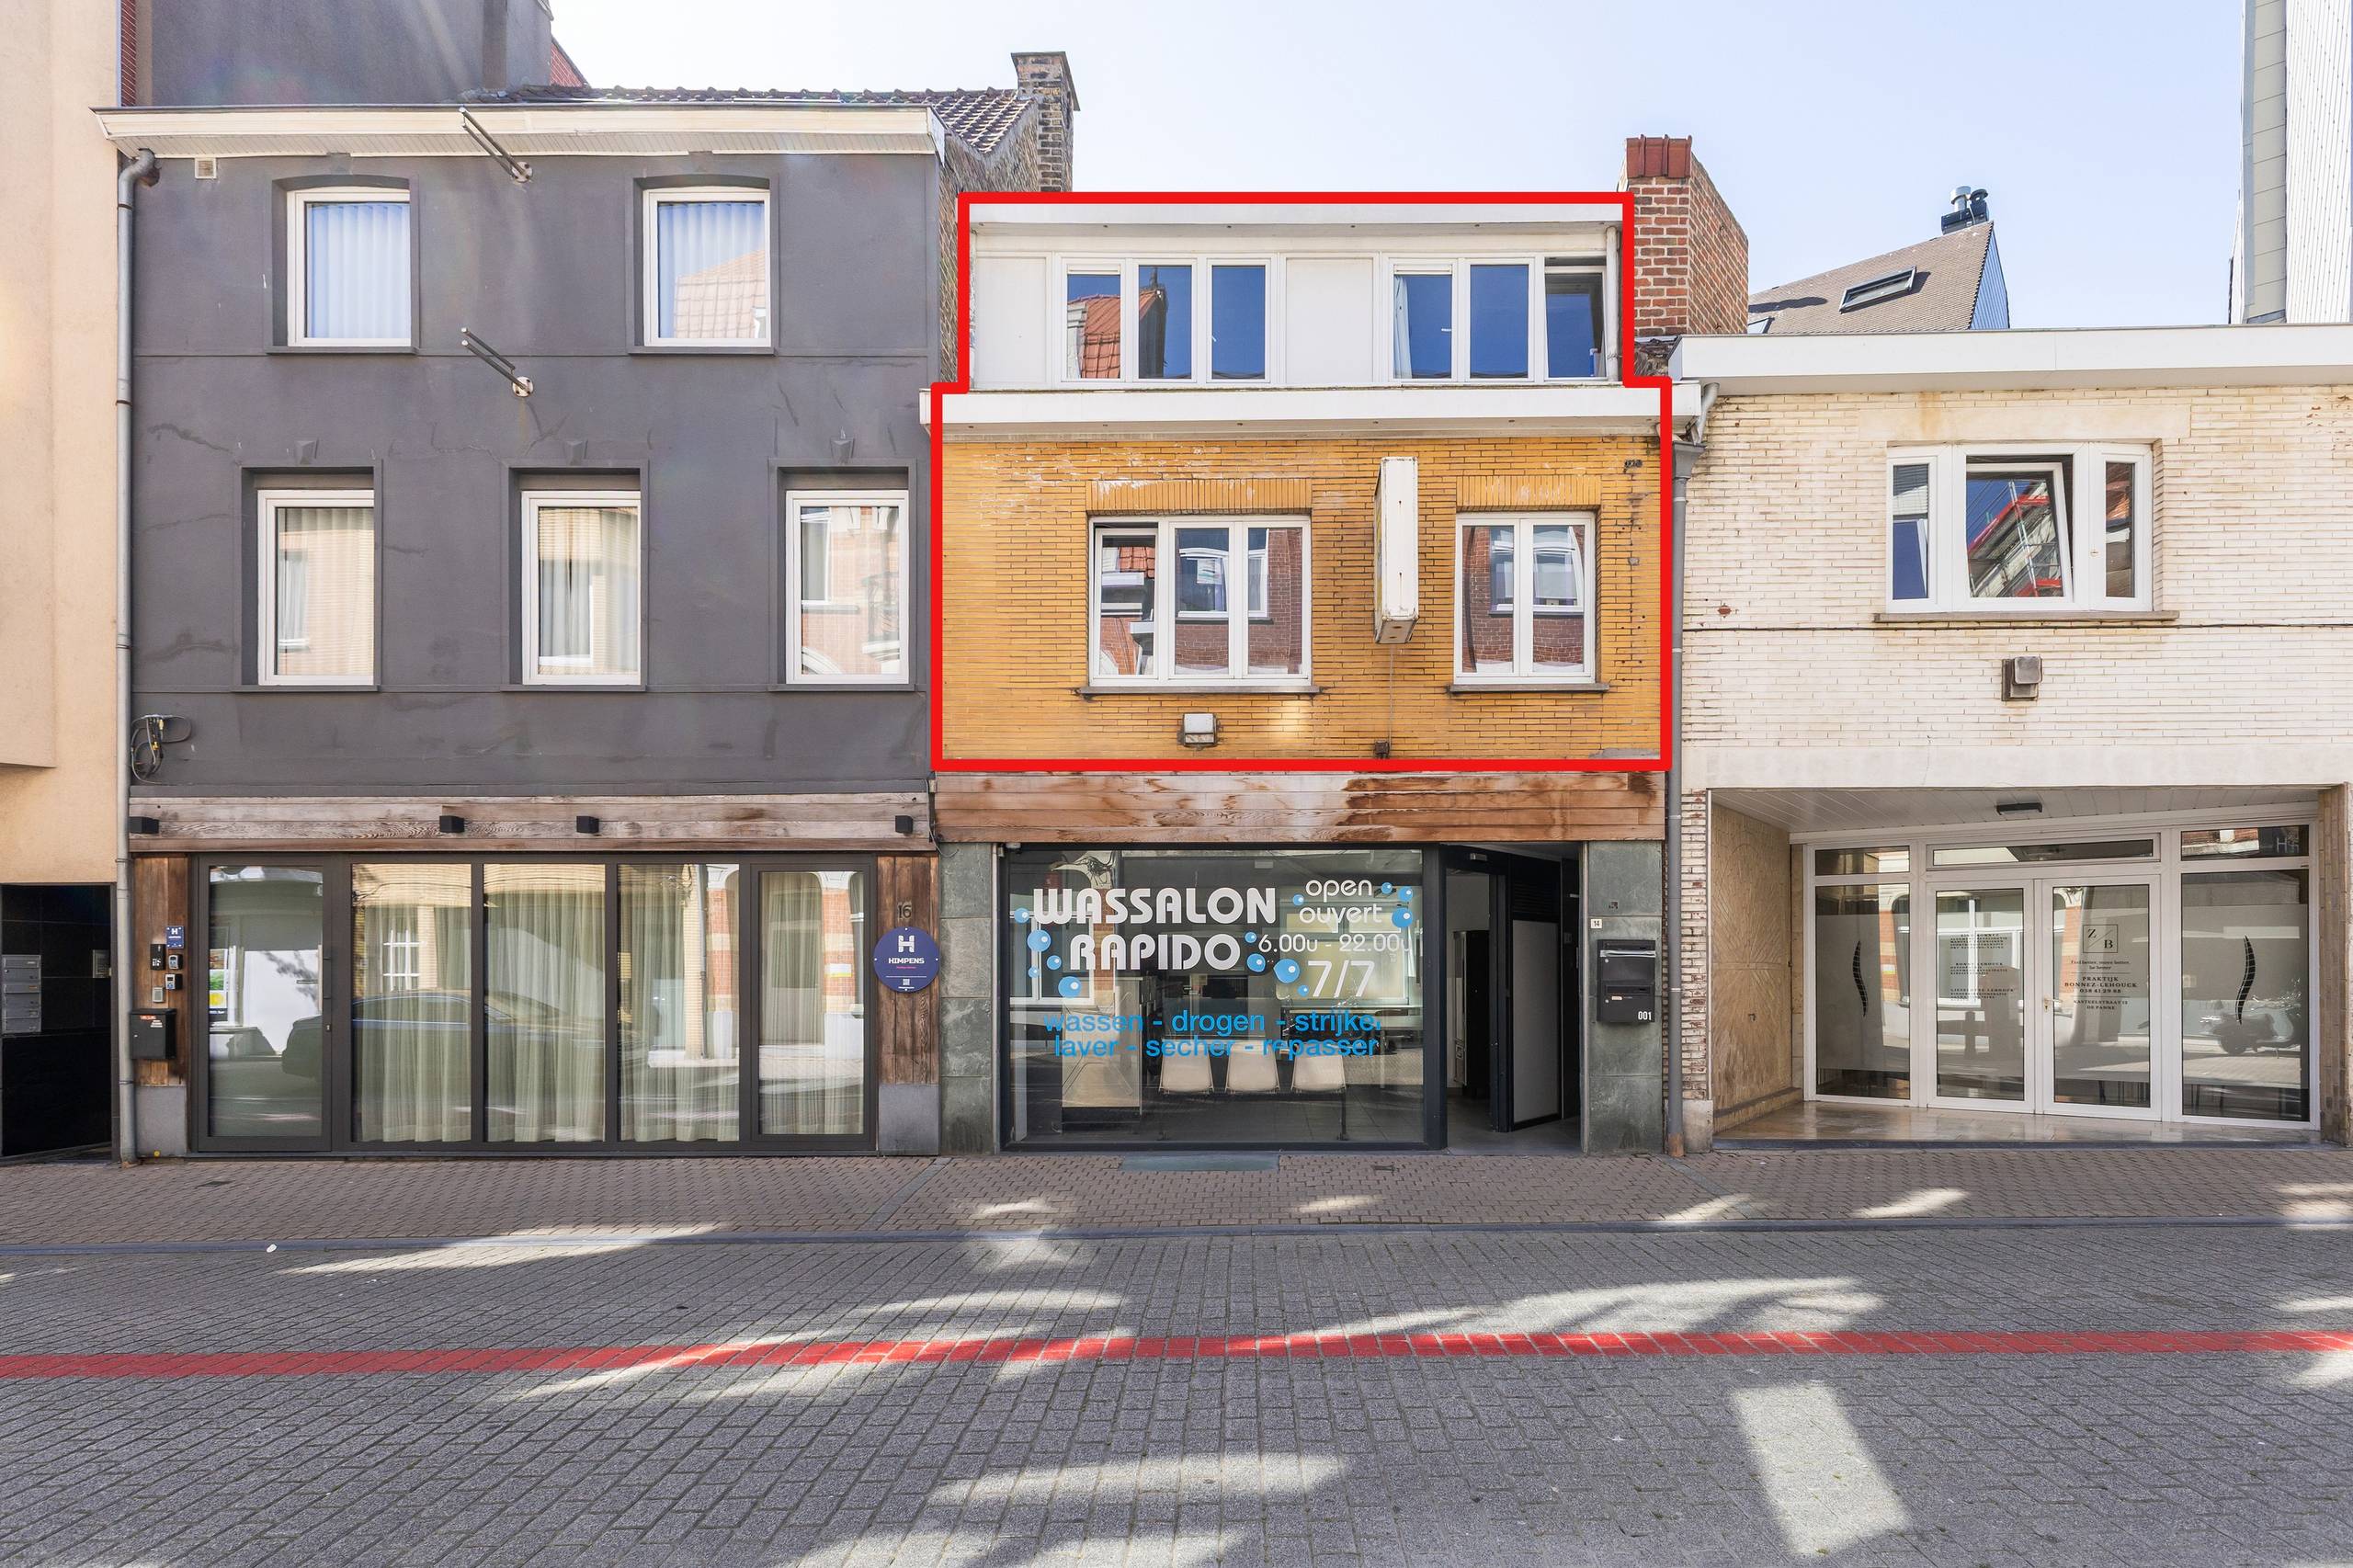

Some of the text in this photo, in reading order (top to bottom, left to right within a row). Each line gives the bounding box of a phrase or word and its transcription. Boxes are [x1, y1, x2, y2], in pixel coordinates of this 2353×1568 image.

[1305, 880, 1372, 903] open
[897, 904, 912, 919] 16
[1033, 887, 1276, 925] WASSALON
[1299, 903, 1382, 924] ouvert
[898, 935, 915, 953] H
[1070, 934, 1241, 971] RAPIDO
[1258, 934, 1318, 952] 6.00u
[1307, 960, 1375, 998] 7/7
[1043, 1014, 1143, 1032] wassen
[1171, 1009, 1265, 1037] drogen
[1637, 1011, 1652, 1020] 001
[1055, 1035, 1119, 1057] laver
[1145, 1035, 1235, 1057] secher
[1263, 1039, 1380, 1061] repasser
